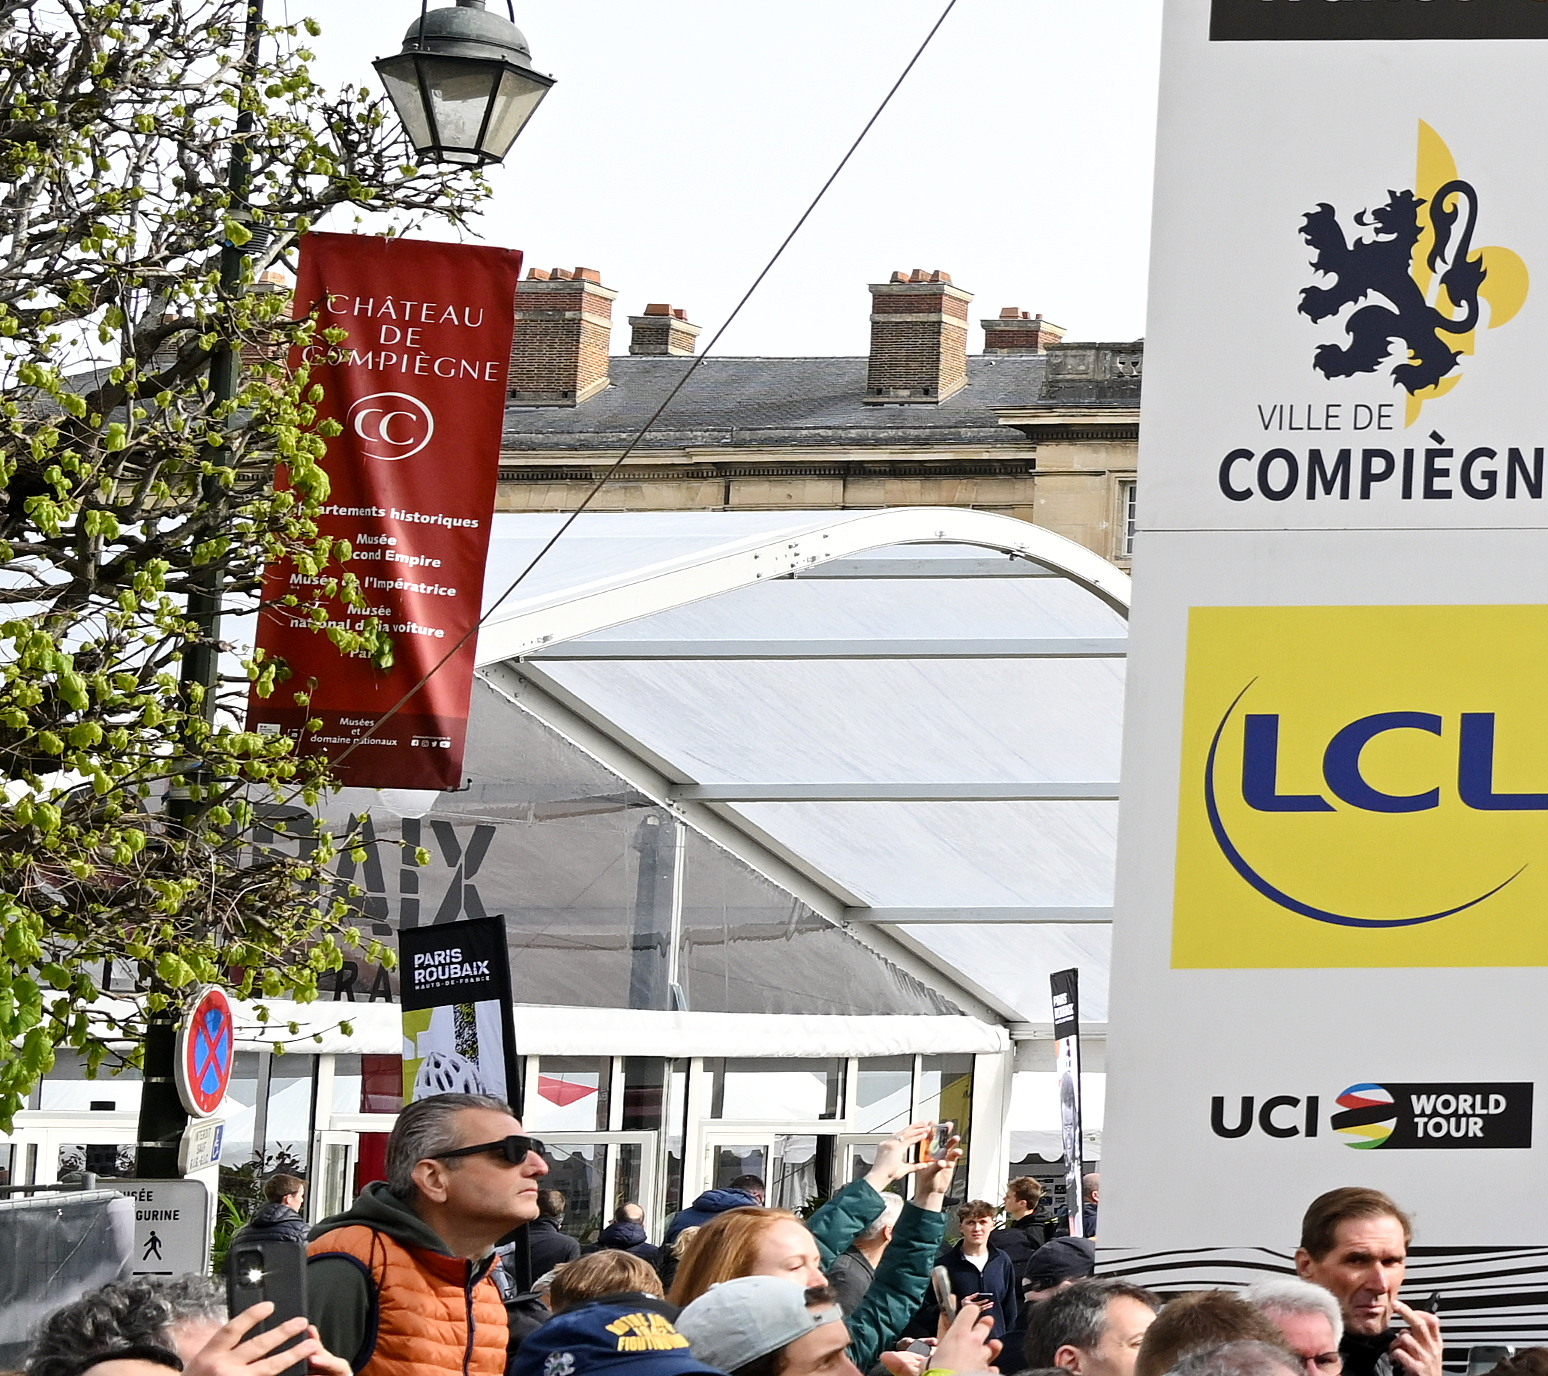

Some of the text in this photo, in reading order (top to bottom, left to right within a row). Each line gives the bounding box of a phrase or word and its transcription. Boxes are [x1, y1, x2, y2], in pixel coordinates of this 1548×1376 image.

[326, 293, 484, 328] CHÂTEAU
[379, 325, 423, 348] DE
[1258, 403, 1395, 431] VILLE DE
[390, 507, 479, 529] historiques
[356, 533, 397, 546] Musée
[385, 549, 442, 568] Empire
[364, 576, 457, 597] l'Impératrice
[347, 604, 392, 616] Musée
[393, 621, 445, 638] voiture
[413, 947, 463, 969] PARIS
[413, 959, 490, 984] ROUBAIX
[414, 974, 492, 992] HAUTS-DE-FRANCE
[1210, 1093, 1507, 1138] UCI WORLD
[1413, 1116, 1485, 1138] TOUR
